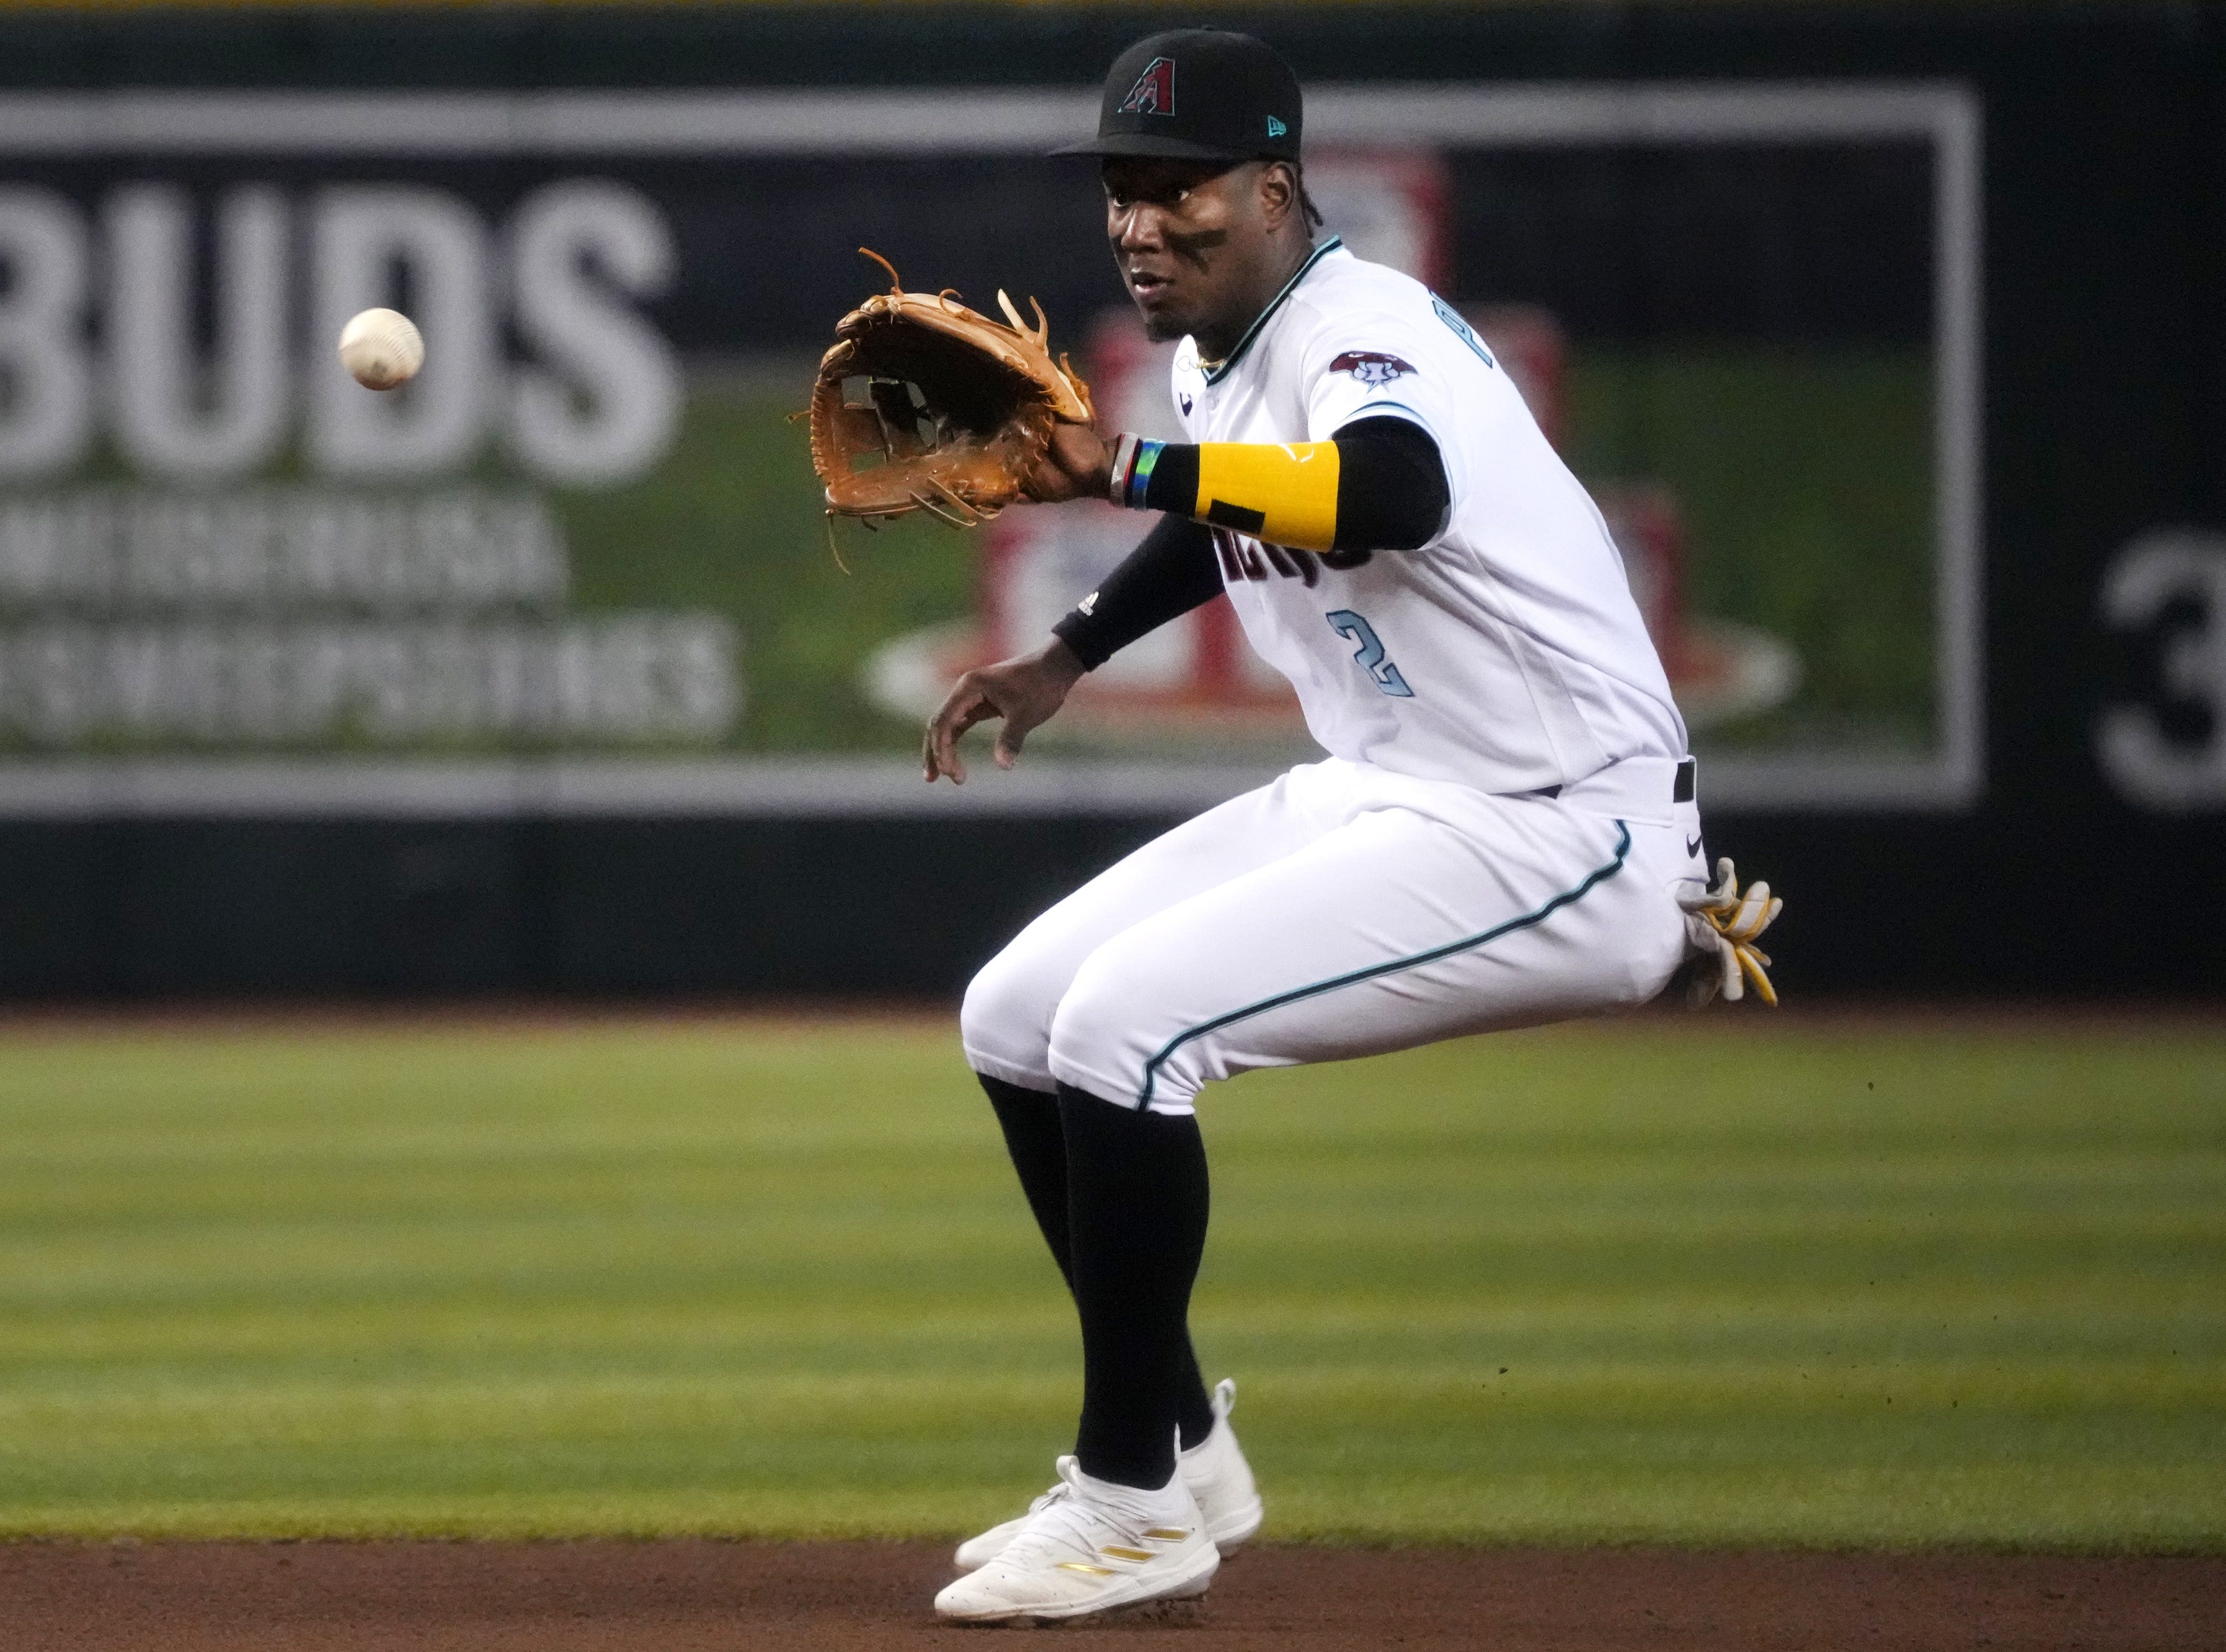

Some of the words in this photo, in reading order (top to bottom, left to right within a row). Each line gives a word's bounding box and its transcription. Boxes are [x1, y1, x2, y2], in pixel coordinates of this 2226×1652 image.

[0, 180, 677, 491] BUDS
[1325, 609, 1415, 697] 2
[2101, 533, 2226, 804] 3
